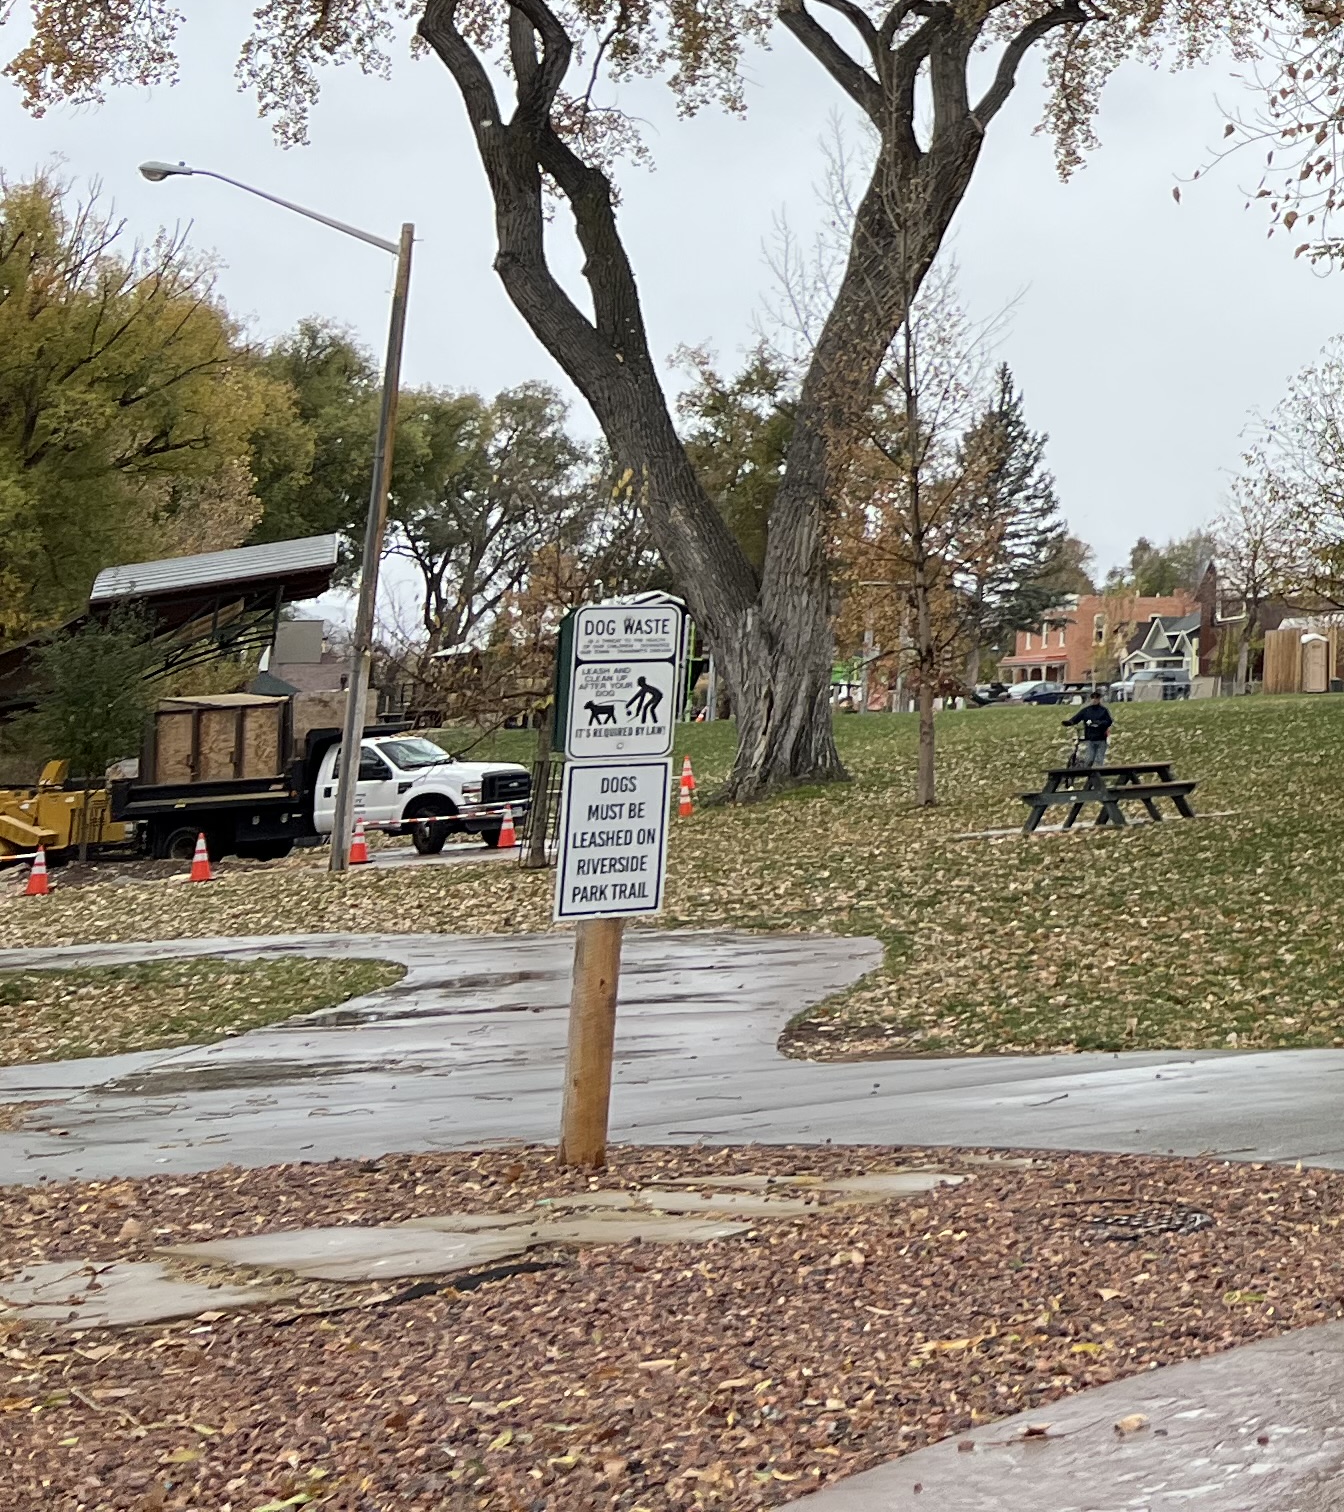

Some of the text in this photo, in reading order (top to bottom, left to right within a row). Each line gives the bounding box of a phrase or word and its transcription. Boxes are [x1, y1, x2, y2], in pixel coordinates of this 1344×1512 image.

[584, 618, 670, 636] DOG WASTE
[582, 667, 610, 675] LEASH
[575, 728, 591, 738] IT'S
[592, 727, 633, 738] REQUIRED
[635, 727, 645, 736] BY
[600, 776, 637, 794] DOGS
[587, 802, 646, 821] MUST BE
[572, 828, 656, 849] LEASHED ON
[576, 855, 648, 876] RIVERSIDE
[571, 881, 649, 903] PARK TRAIL
